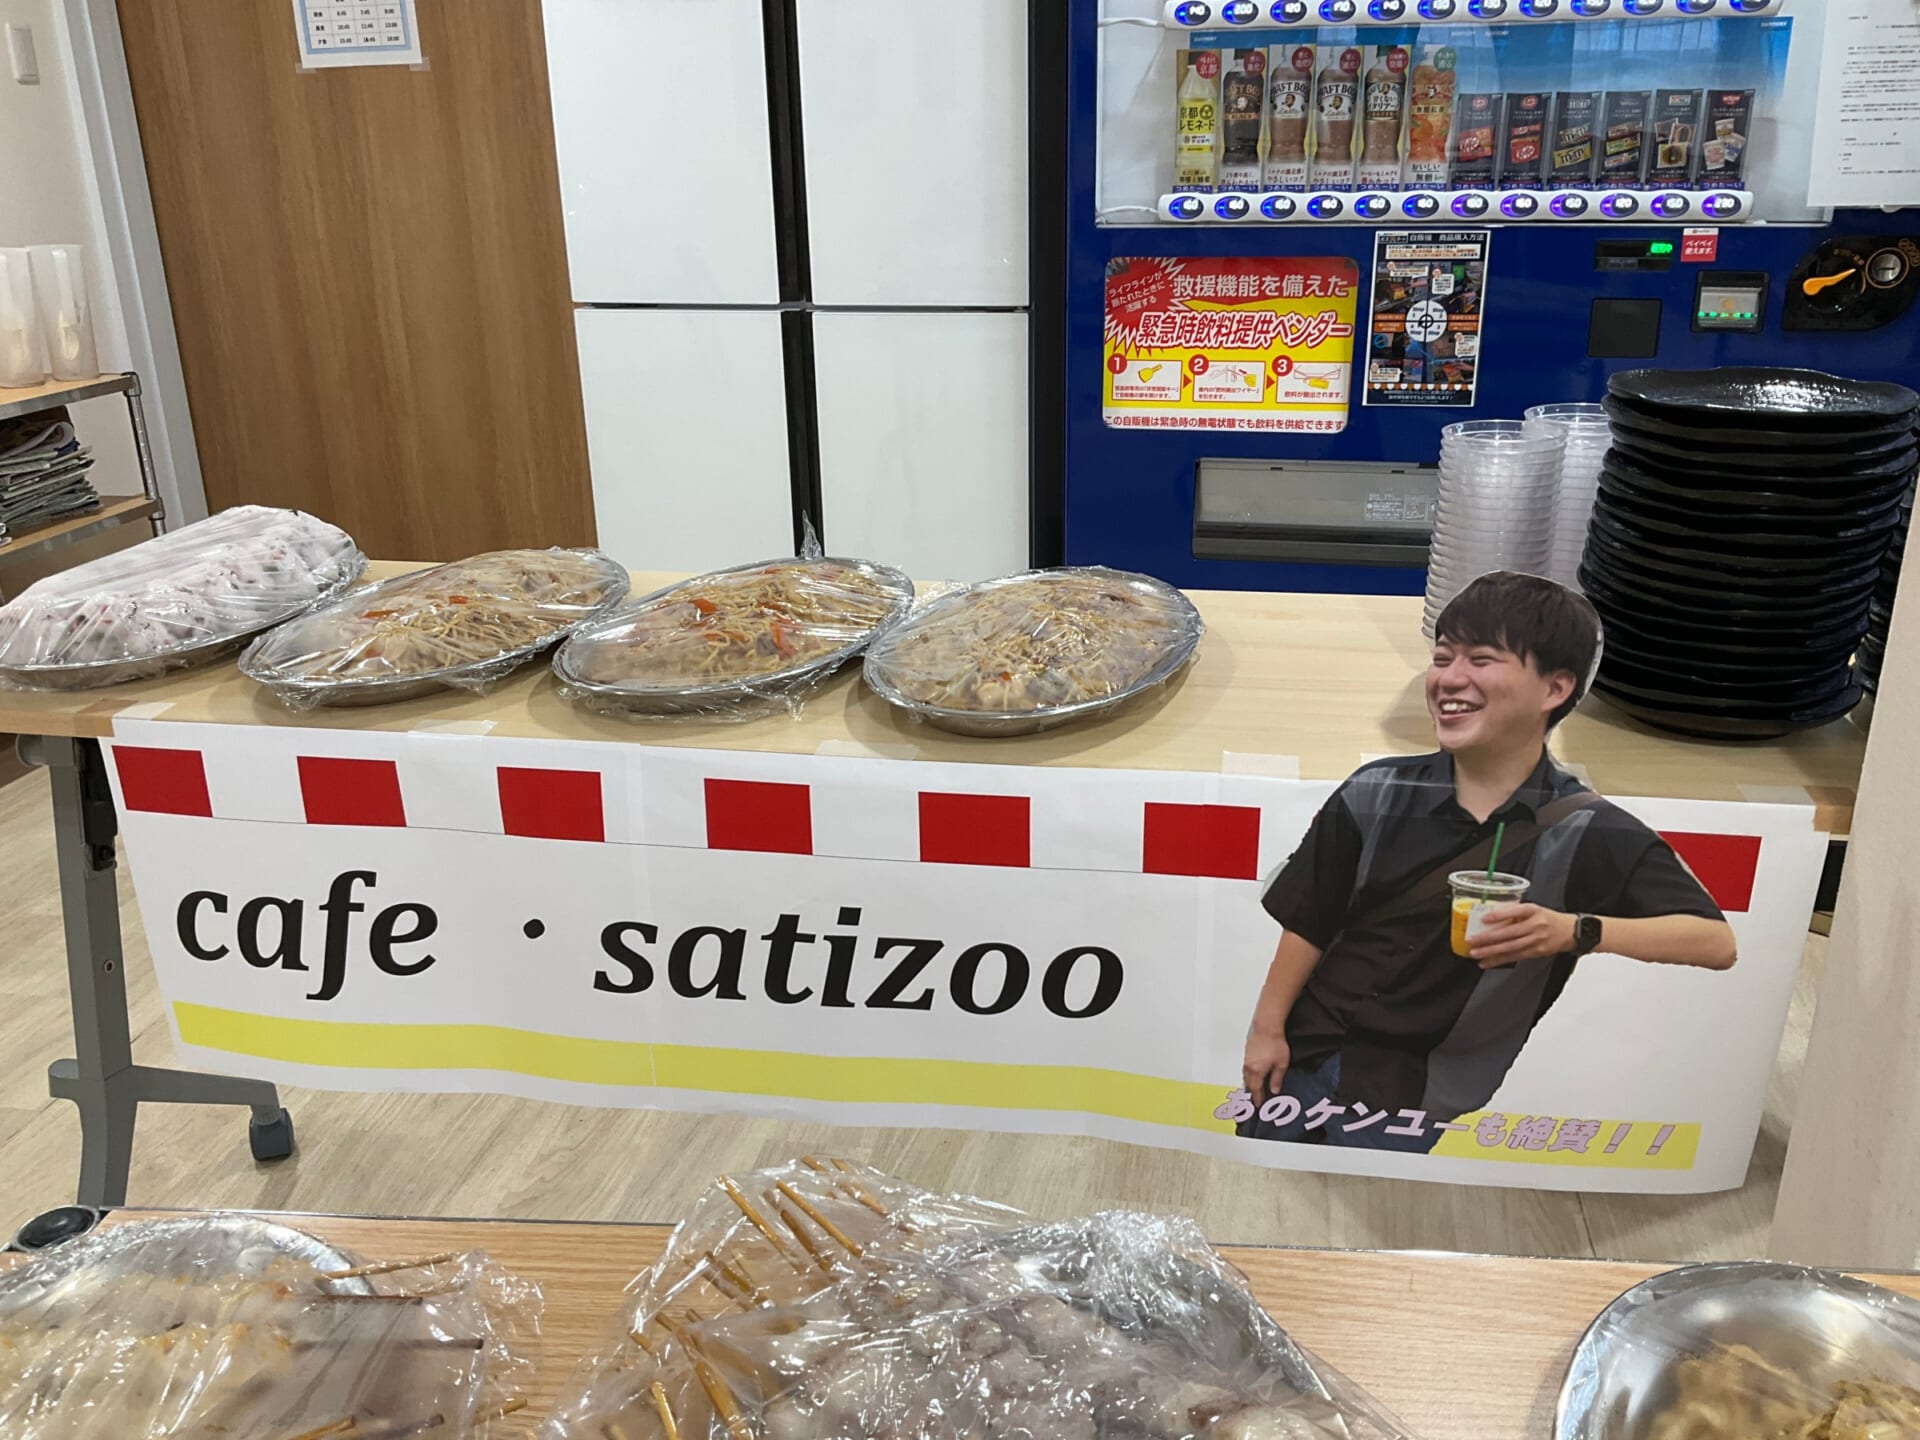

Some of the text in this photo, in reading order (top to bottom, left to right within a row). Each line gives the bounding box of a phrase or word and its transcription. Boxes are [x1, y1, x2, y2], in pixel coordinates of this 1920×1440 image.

[1108, 271, 1163, 298] ライフラインが
[1173, 274, 1348, 298] 救援機能を備えた
[1137, 312, 1352, 348] 緊急時飲料提供ベンダー
[1113, 357, 1120, 371] 1
[1193, 358, 1203, 373] 2
[1277, 359, 1287, 373] 3
[176, 870, 438, 1001] cafe
[593, 906, 1124, 1019] satizoo
